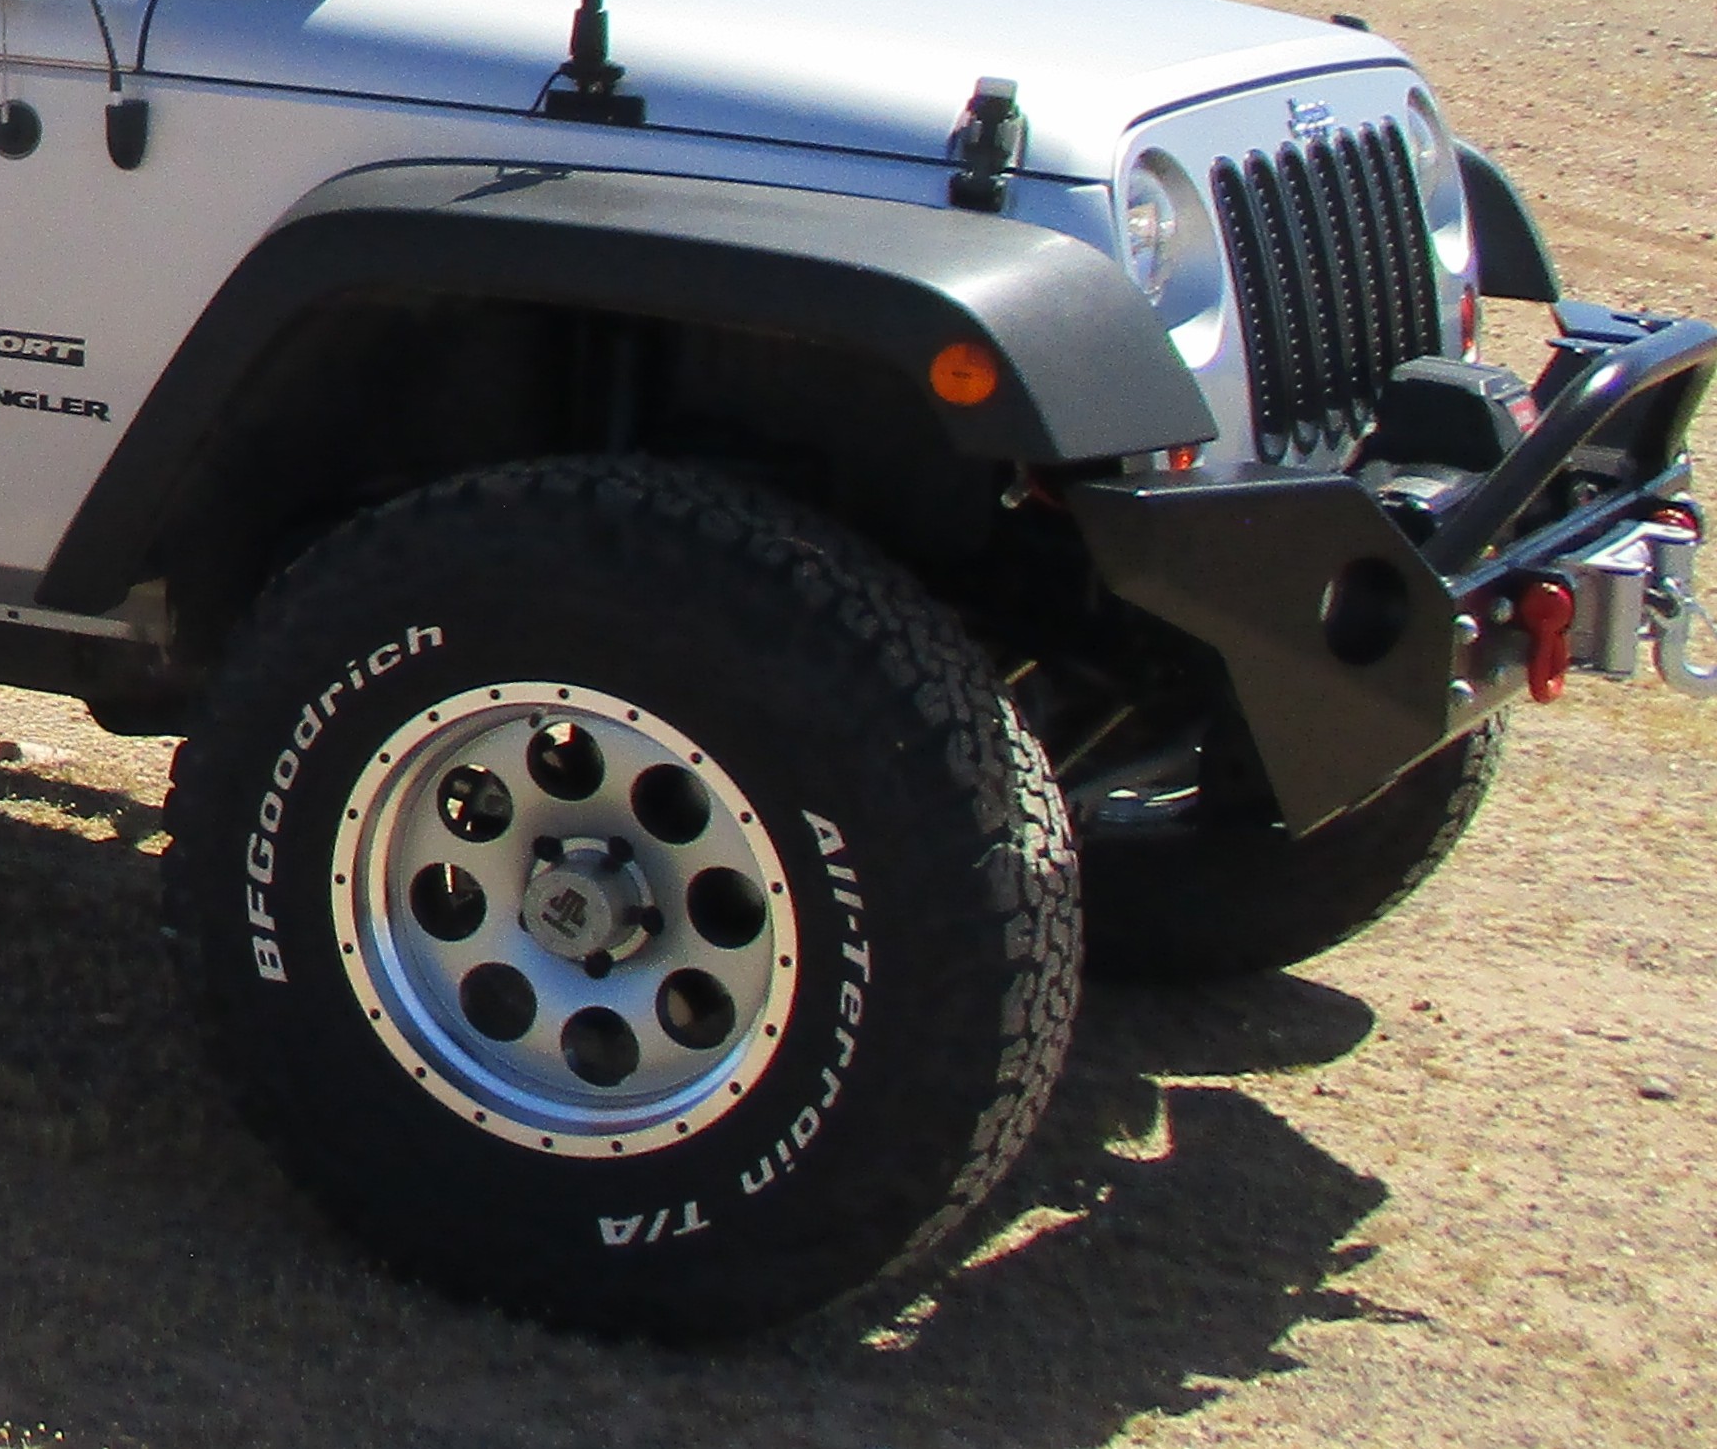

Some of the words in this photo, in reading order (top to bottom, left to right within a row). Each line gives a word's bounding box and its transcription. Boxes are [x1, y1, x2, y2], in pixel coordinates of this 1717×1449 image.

[246, 625, 444, 984] BFGoodrich
[740, 809, 872, 1195] All-Terrain
[598, 1201, 710, 1246] T/A
